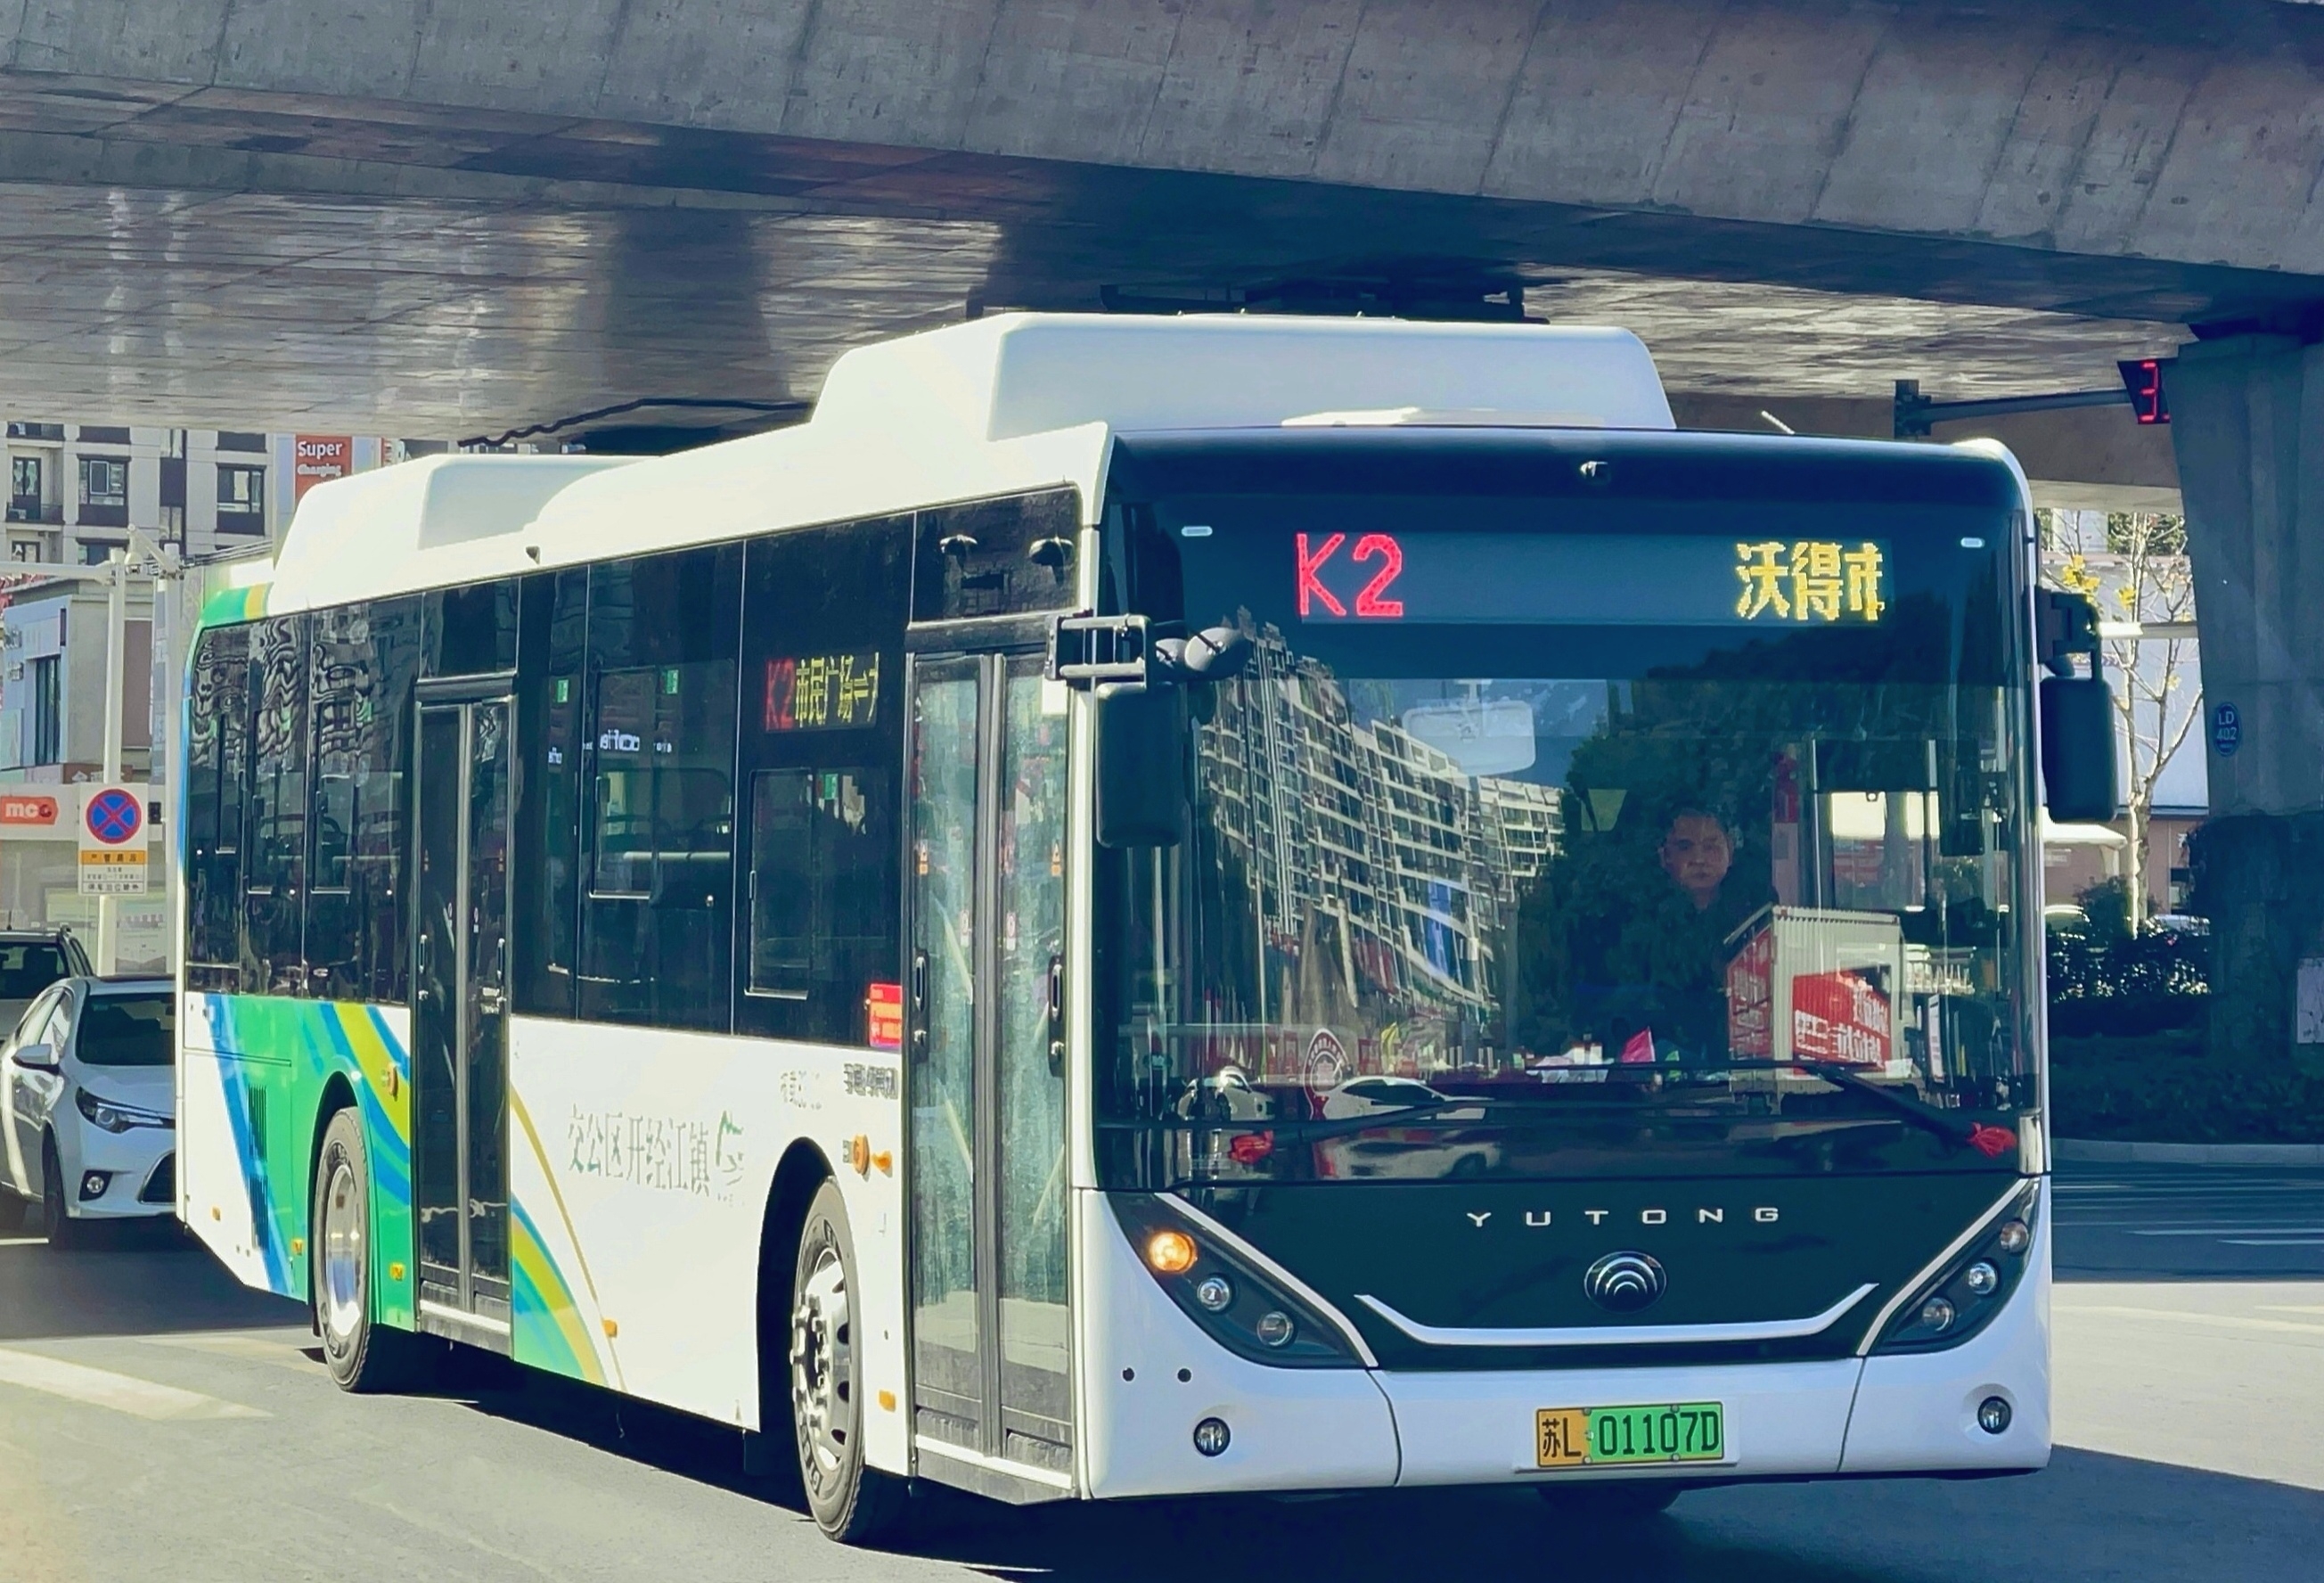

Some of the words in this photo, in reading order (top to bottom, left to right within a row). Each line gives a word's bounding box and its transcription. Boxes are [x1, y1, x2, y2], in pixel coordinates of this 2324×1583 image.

[298, 440, 343, 460] Super
[1296, 532, 1404, 618] K2
[766, 659, 795, 732] K2
[2218, 710, 2235, 726] LD
[1466, 1206, 1780, 1228] YUTONG
